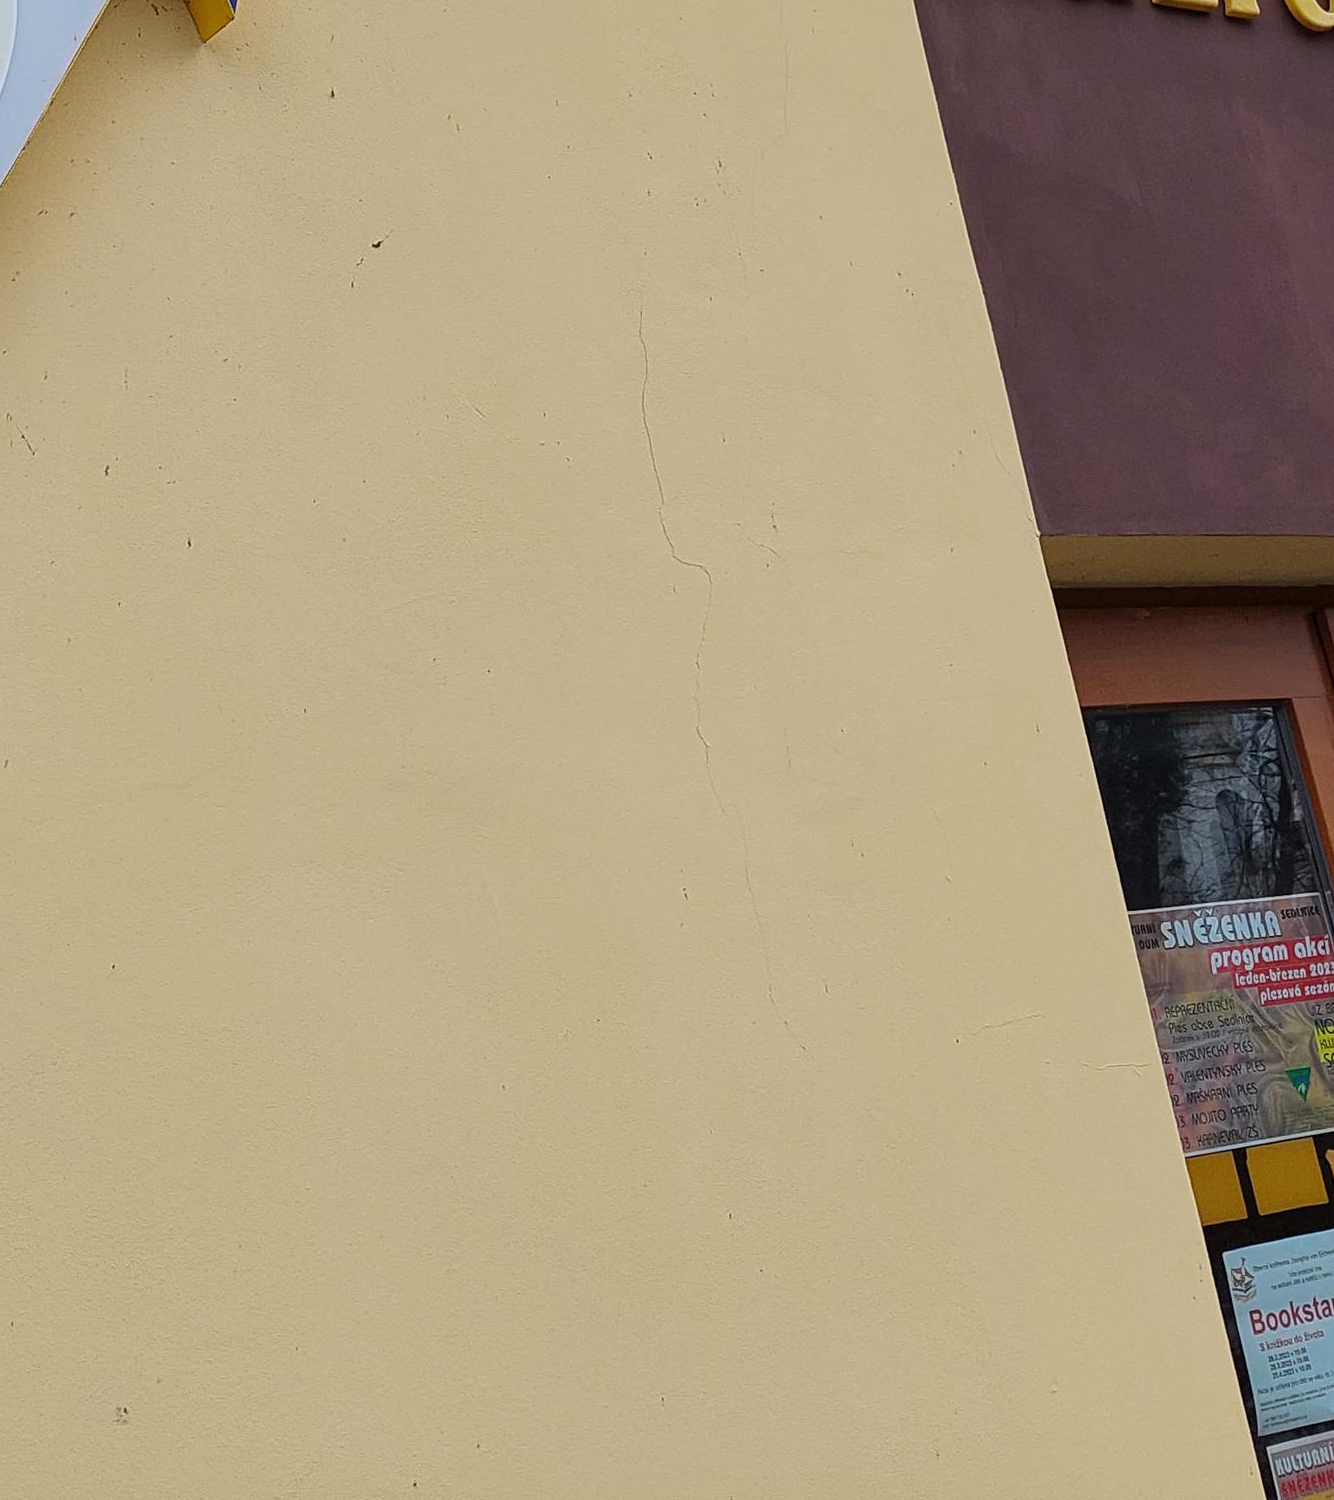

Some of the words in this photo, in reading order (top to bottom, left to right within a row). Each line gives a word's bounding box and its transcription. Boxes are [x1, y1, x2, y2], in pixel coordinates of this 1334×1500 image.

[1159, 908, 1283, 950] SNĚŽENKA
[1210, 943, 1289, 975] program
[1294, 933, 1331, 957] akcí
[1235, 968, 1308, 988] leden-březen
[1260, 984, 1303, 1006] plesová
